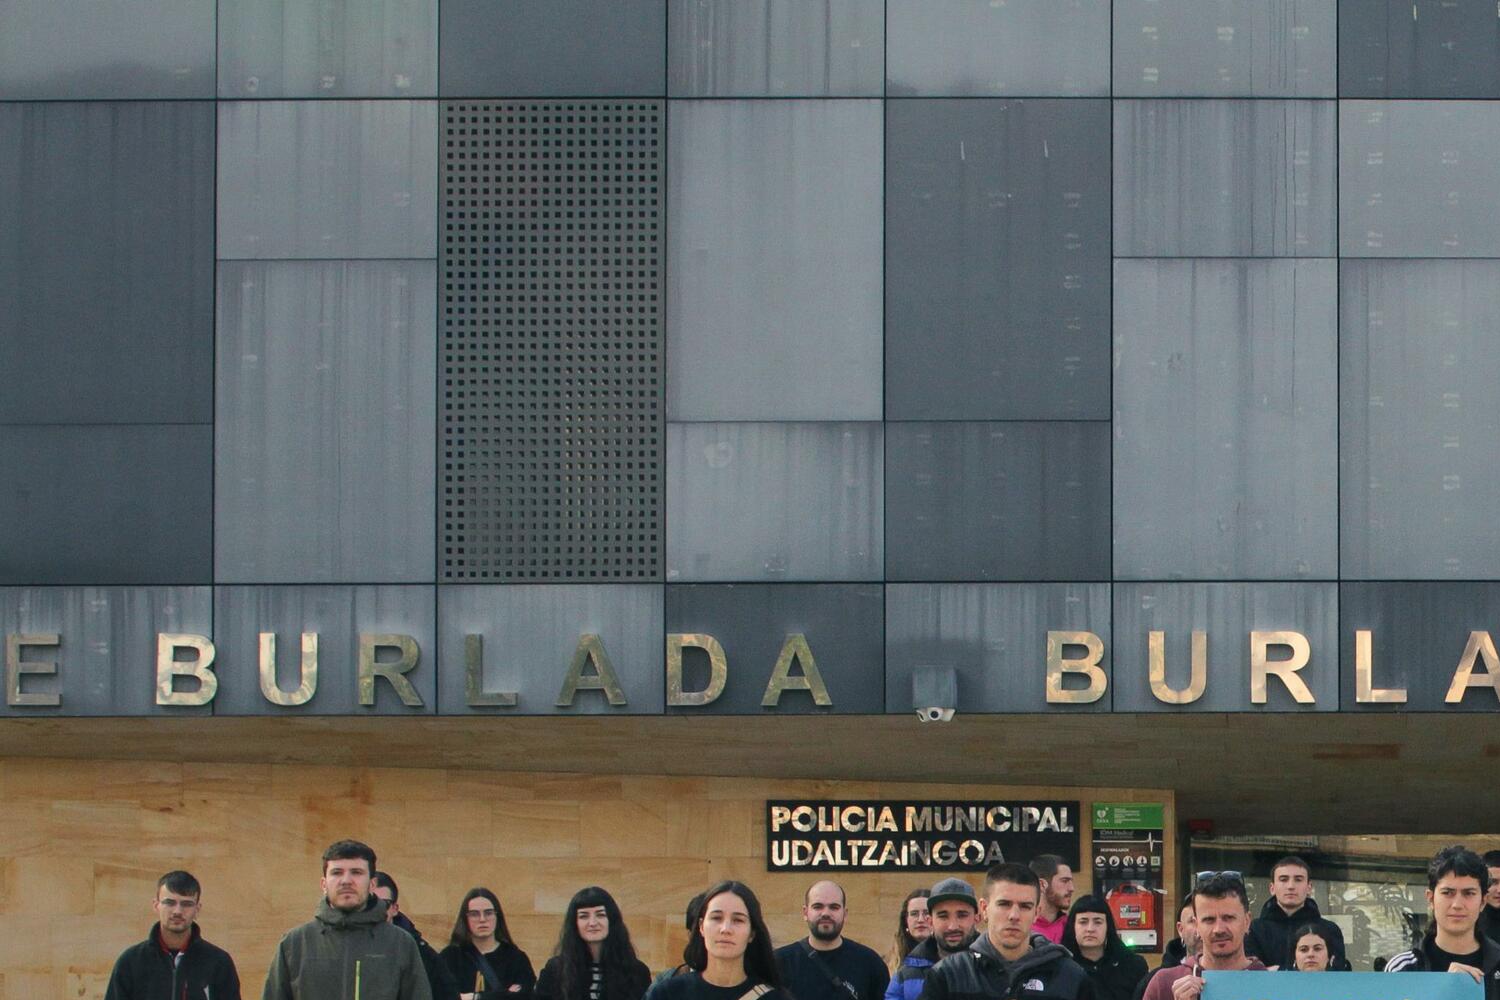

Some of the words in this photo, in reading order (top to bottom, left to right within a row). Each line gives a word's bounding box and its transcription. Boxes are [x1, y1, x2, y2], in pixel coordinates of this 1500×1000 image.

[6, 633, 61, 706] E
[156, 632, 833, 706] BURLADA
[772, 806, 898, 833] POLICIA
[905, 806, 1074, 833] MUNICIPAL
[772, 839, 1005, 866] UDALTZAINGOA
